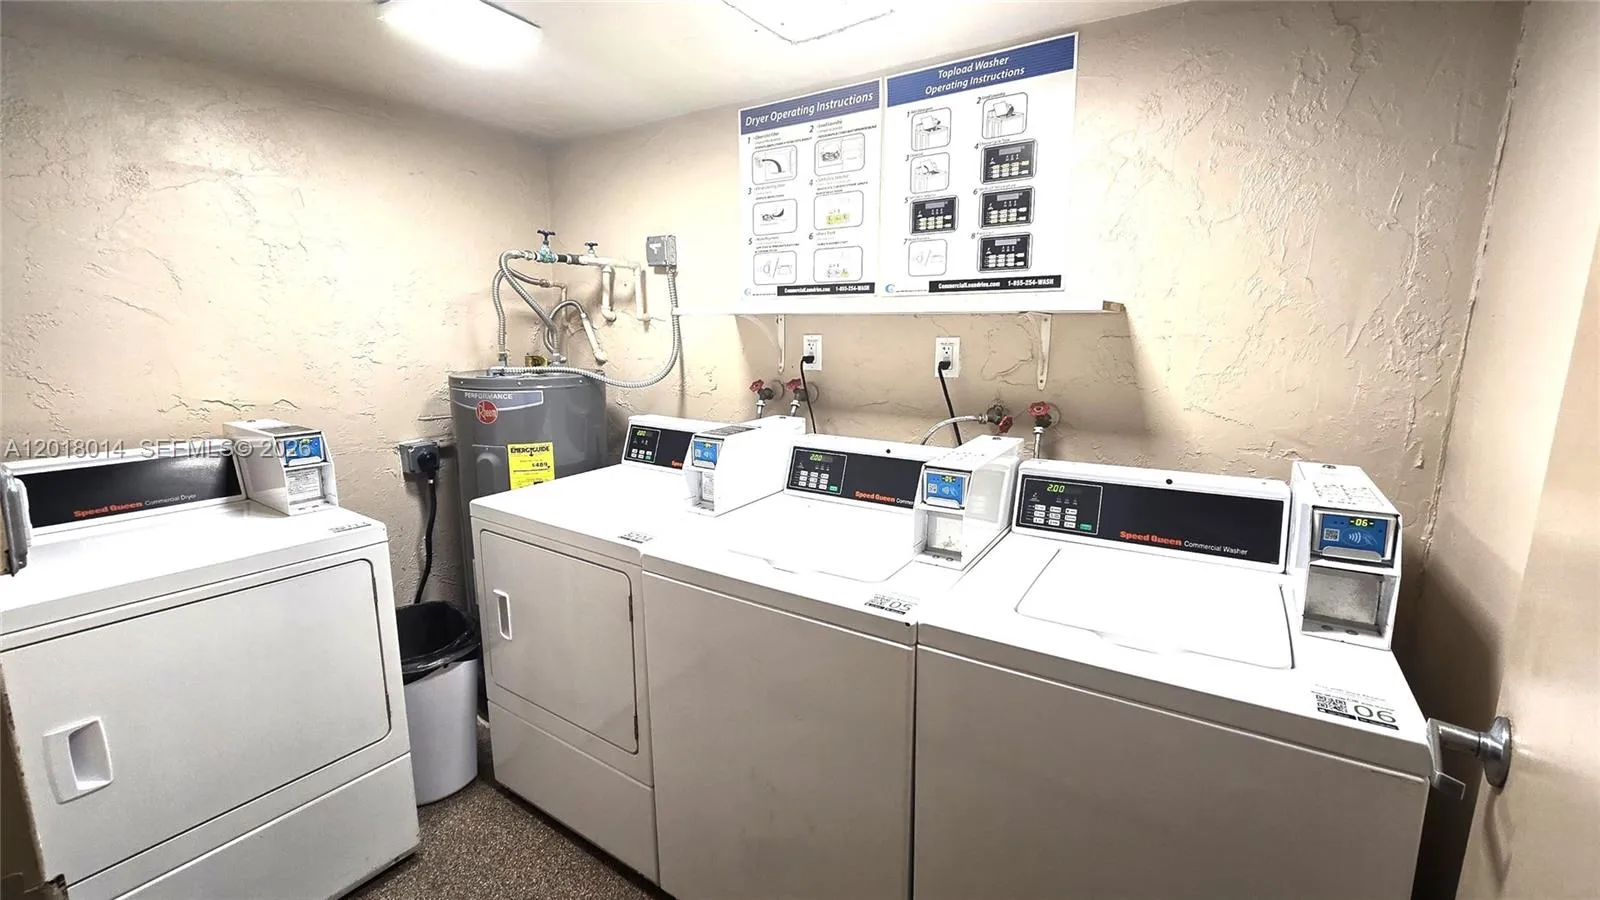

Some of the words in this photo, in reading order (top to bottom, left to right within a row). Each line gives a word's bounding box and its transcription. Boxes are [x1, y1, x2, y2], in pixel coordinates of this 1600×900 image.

[938, 63, 973, 79] Topload
[975, 56, 1009, 71] Washer
[925, 78, 968, 95] Operating
[970, 66, 1025, 85] Instructions
[745, 115, 770, 127] Dryer
[770, 105, 815, 122] Operating
[817, 92, 873, 112] Instructions
[809, 125, 814, 133] 2
[808, 232, 814, 240] 6
[464, 392, 513, 400] PERFORMANCE
[855, 490, 875, 499] Speed
[875, 493, 896, 503] Queen
[1047, 483, 1065, 493] 2.00
[73, 505, 109, 518] Speed
[109, 501, 143, 512] Queen
[144, 495, 180, 506] Commercial
[180, 493, 197, 501] Dryer
[1120, 530, 1149, 541] Speed
[1151, 534, 1182, 546] Queen
[1183, 540, 1221, 552] Commercial
[1222, 545, 1248, 556] Washer
[1354, 705, 1396, 723] 06
